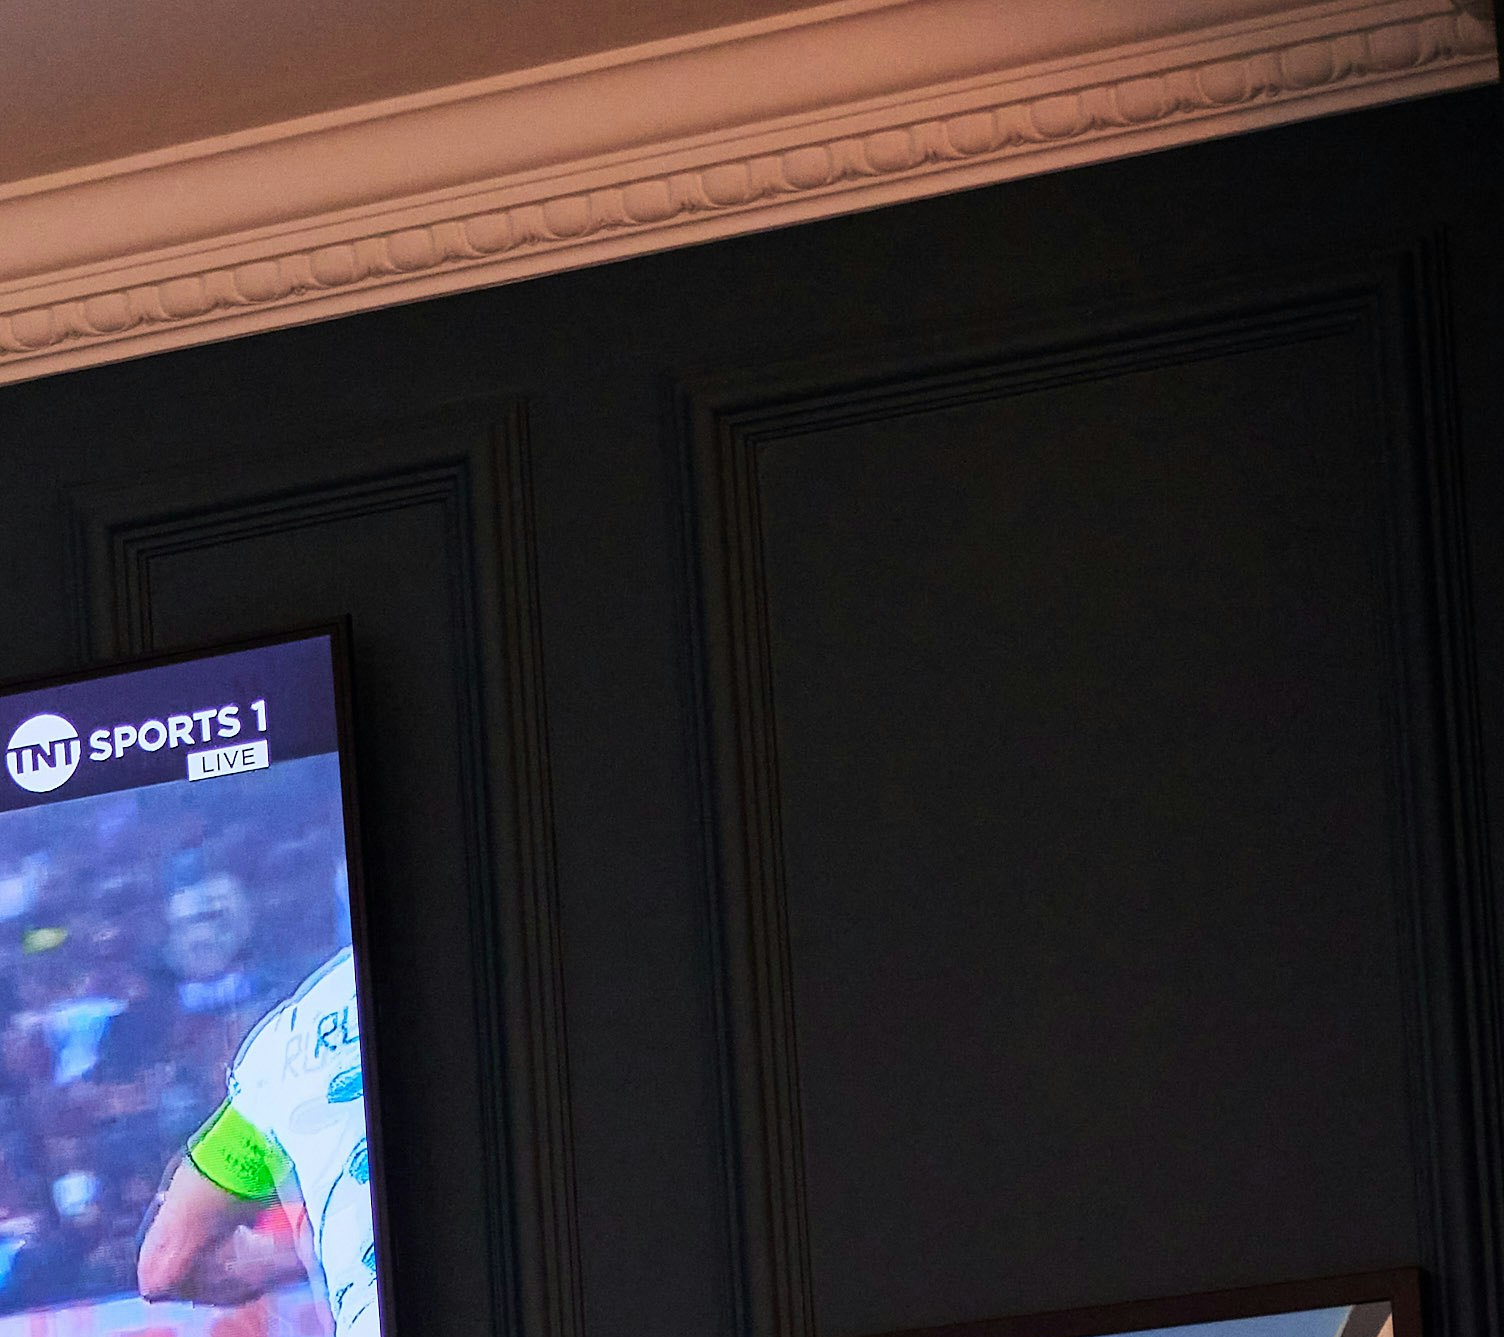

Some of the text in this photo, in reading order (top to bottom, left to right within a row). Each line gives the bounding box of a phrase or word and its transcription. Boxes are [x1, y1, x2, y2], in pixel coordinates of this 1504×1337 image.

[6, 700, 268, 776] TNT SPORTS 1
[201, 747, 257, 774] LIVE
